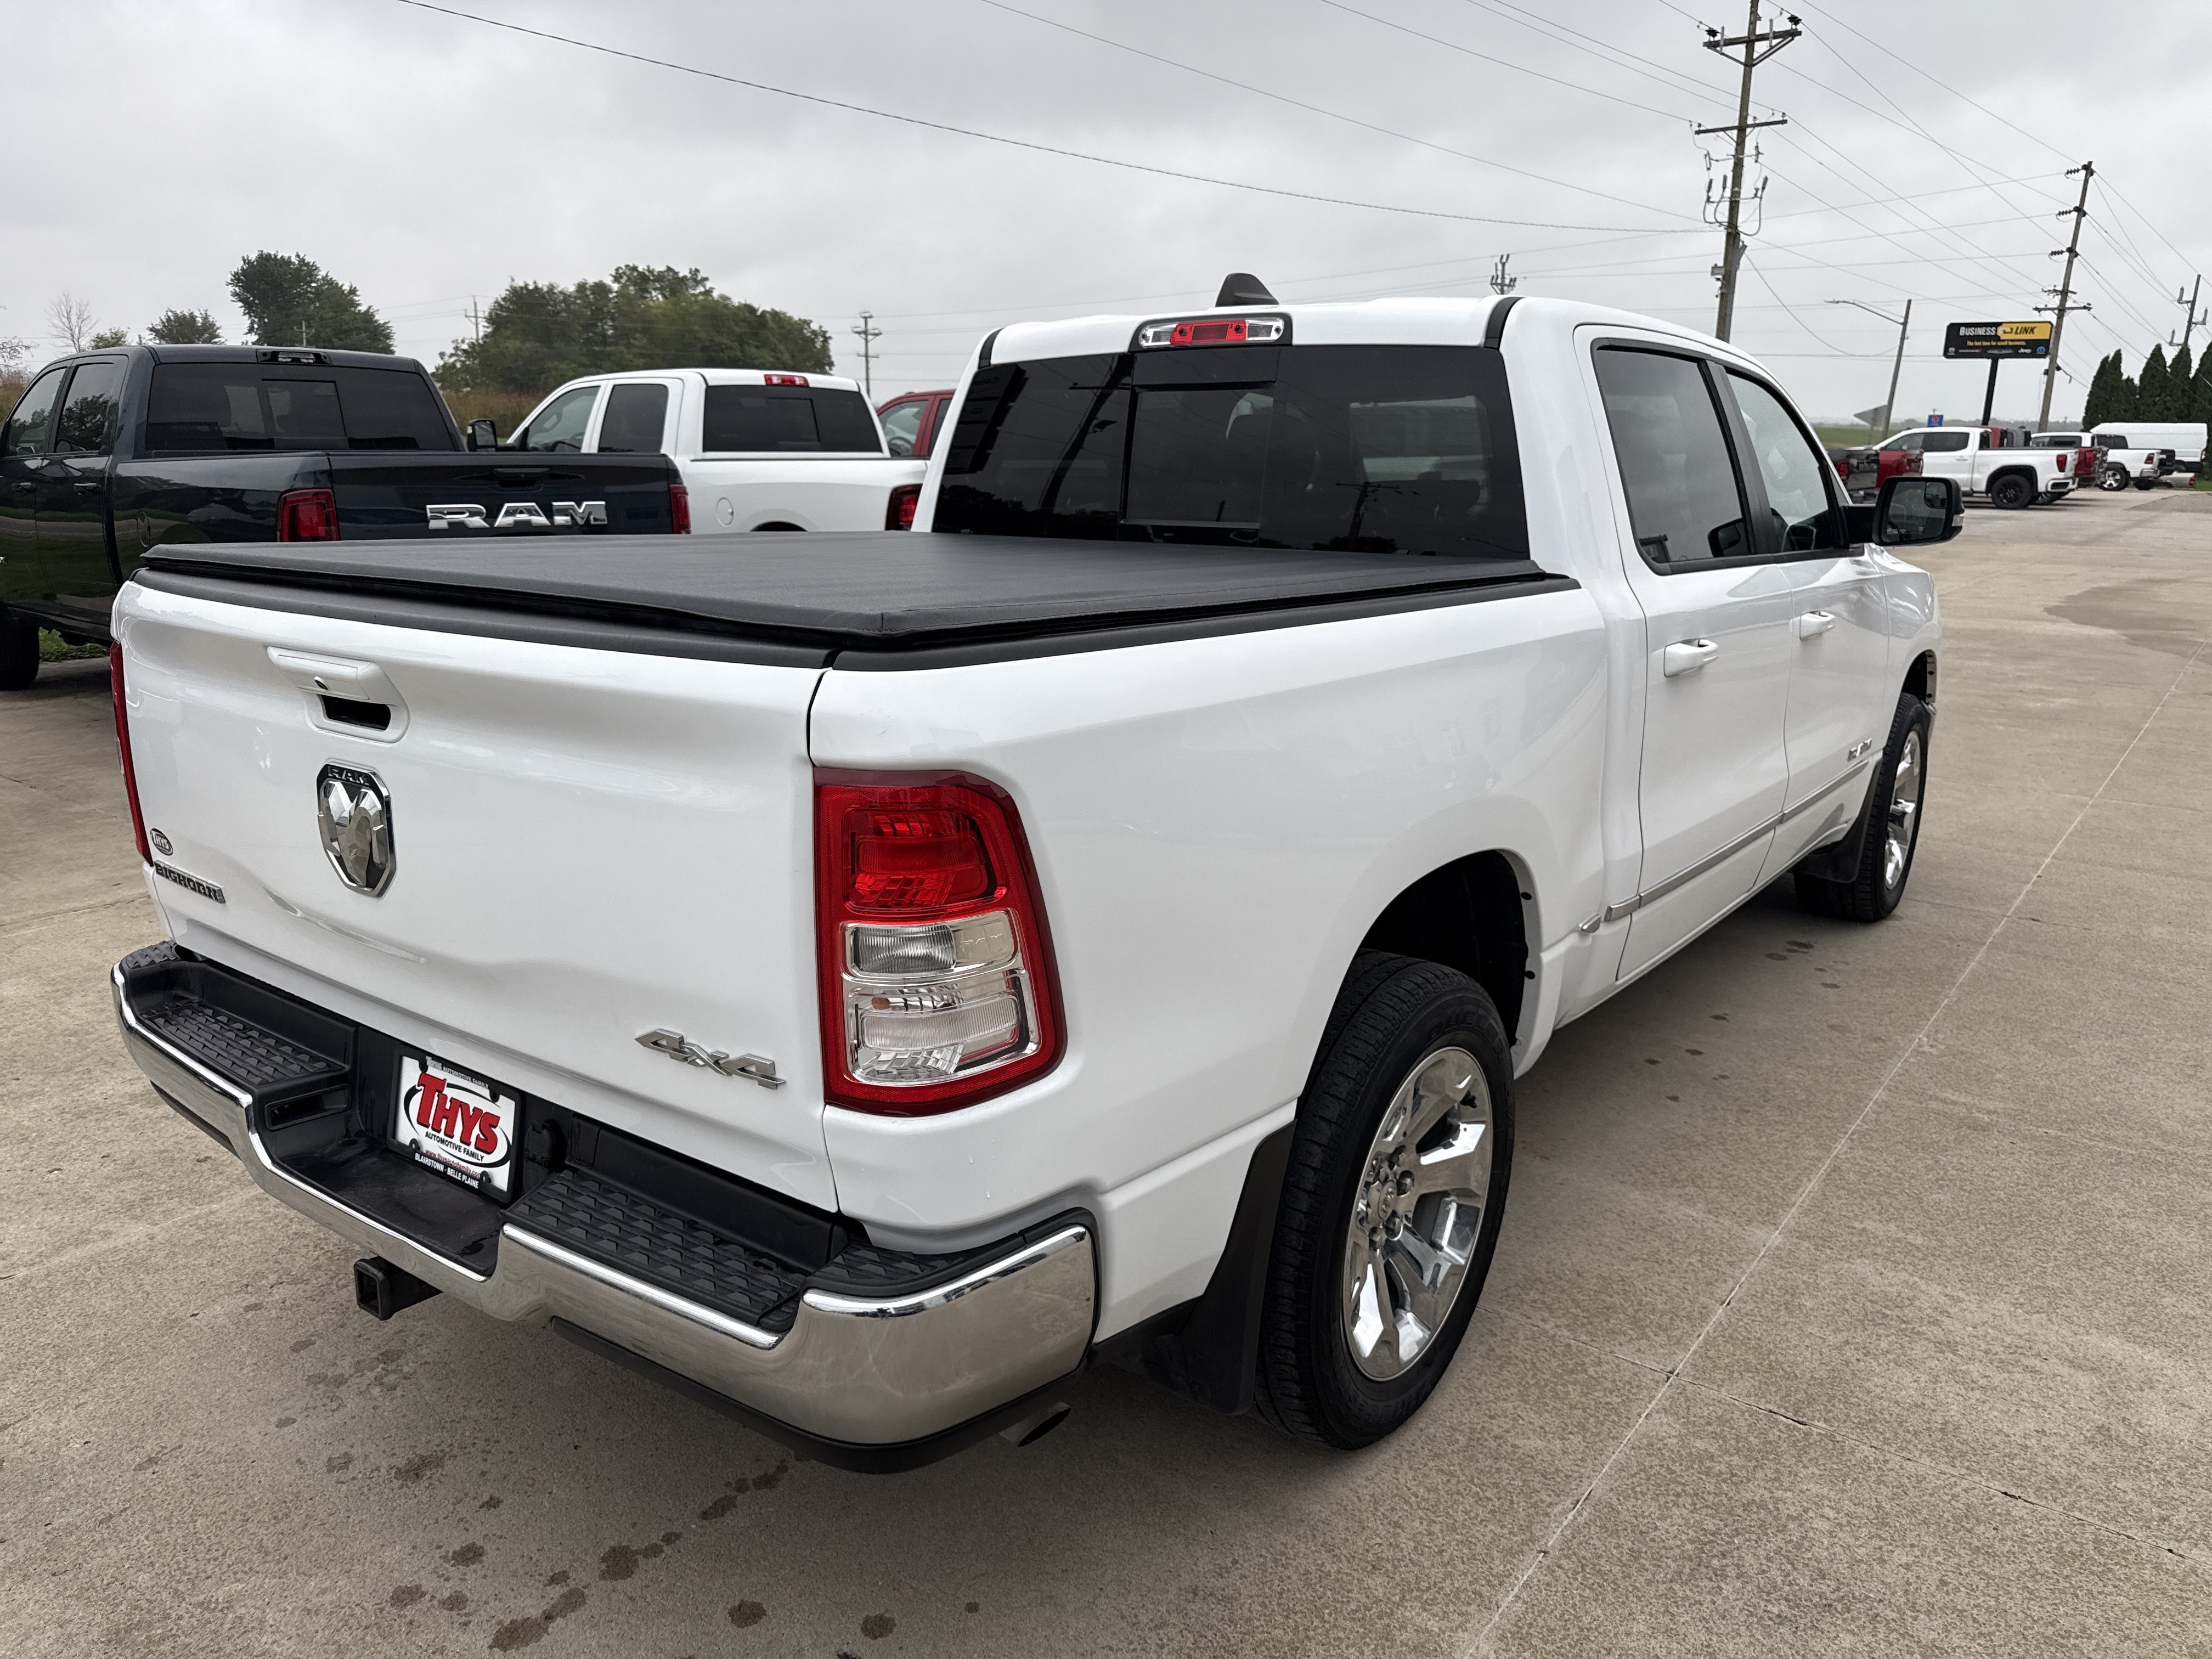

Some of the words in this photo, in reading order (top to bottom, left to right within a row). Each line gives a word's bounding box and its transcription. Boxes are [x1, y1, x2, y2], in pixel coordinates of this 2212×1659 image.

[1959, 326, 1996, 336] BUSINESS
[2014, 326, 2036, 335] LINK
[426, 501, 608, 530] RAM
[328, 765, 370, 786] RAM
[151, 830, 170, 850] THYS
[154, 860, 223, 903] BIGHORN
[472, 1078, 489, 1089] FAMILY
[416, 1072, 501, 1155] THYS
[425, 1131, 462, 1153] AUTOMOTIVE
[463, 1148, 484, 1162] FAMILY
[415, 1153, 444, 1172] BLAIRSTOWN
[447, 1167, 461, 1180] BELLE
[462, 1175, 479, 1189] PLAINE
